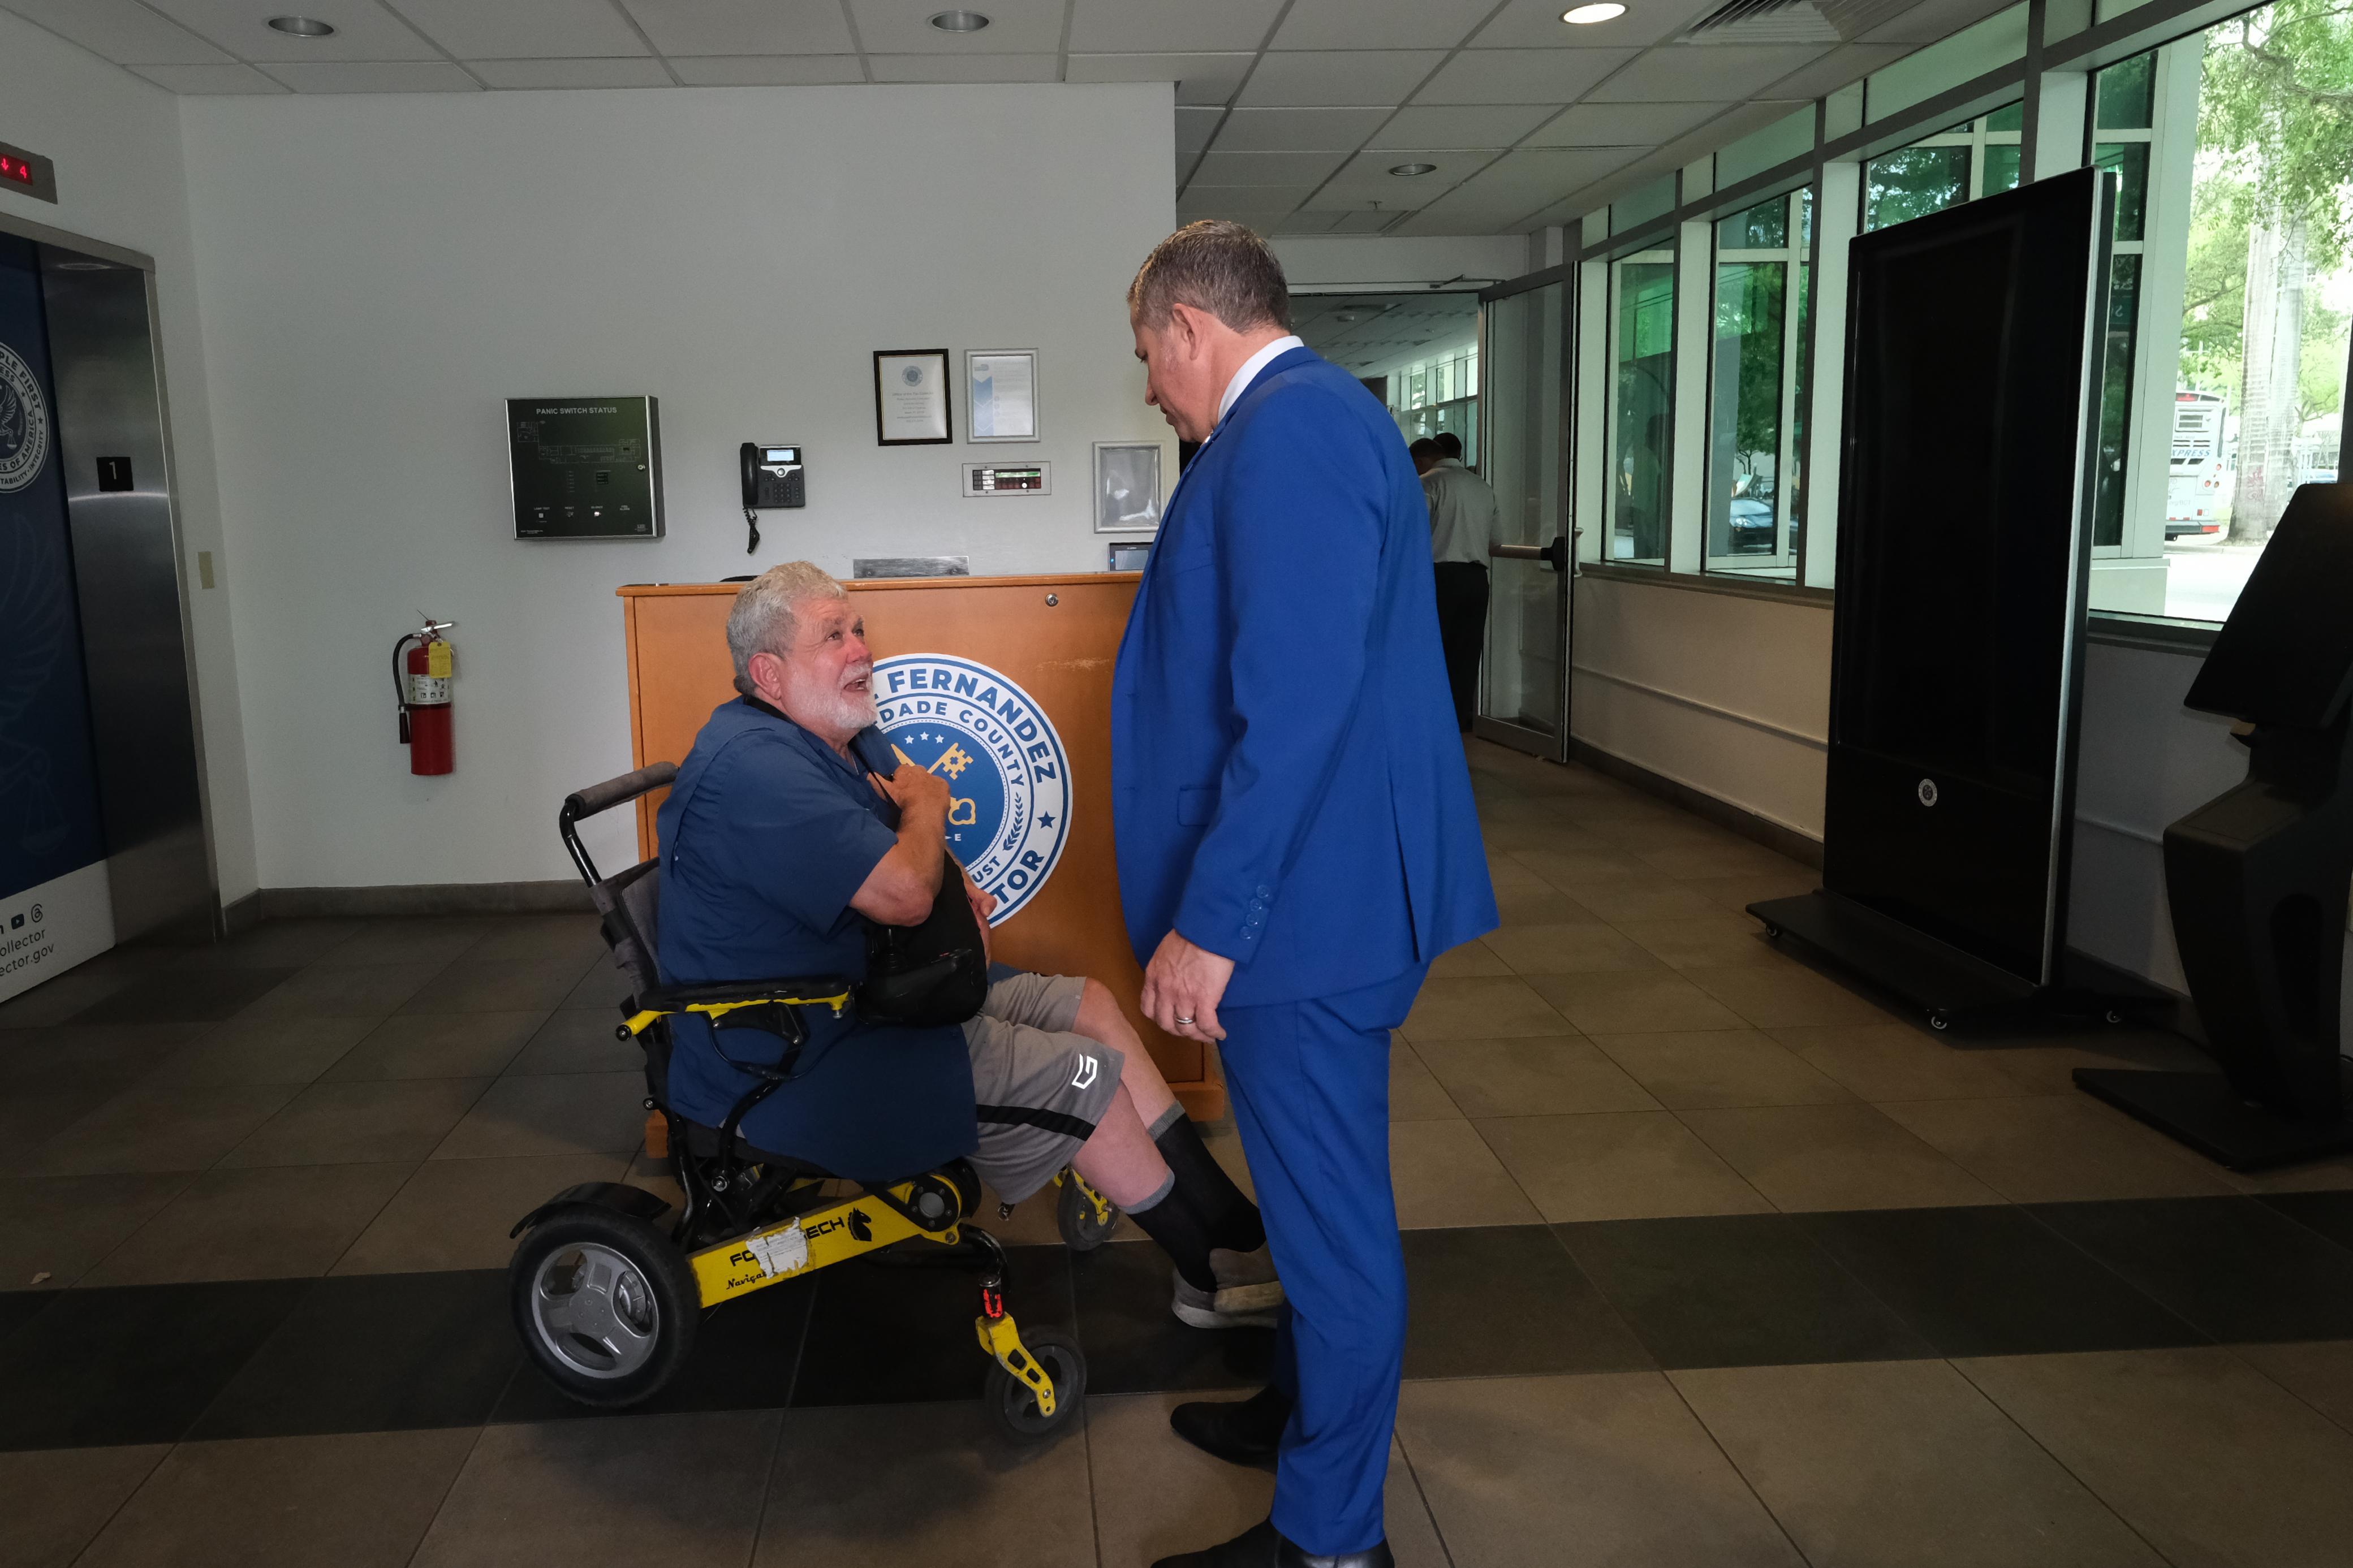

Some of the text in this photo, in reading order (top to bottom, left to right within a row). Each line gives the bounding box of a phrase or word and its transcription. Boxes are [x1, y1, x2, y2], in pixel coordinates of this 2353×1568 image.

[19, 370, 41, 409] FIRST
[10, 457, 20, 469] OF
[22, 410, 35, 460] AMERICA
[28, 430, 44, 470] INTEGRITY
[109, 461, 117, 480] 1
[887, 668, 1057, 783] FERNANDEZ
[959, 709, 1025, 787] COUNTY
[972, 855, 1001, 883] UST
